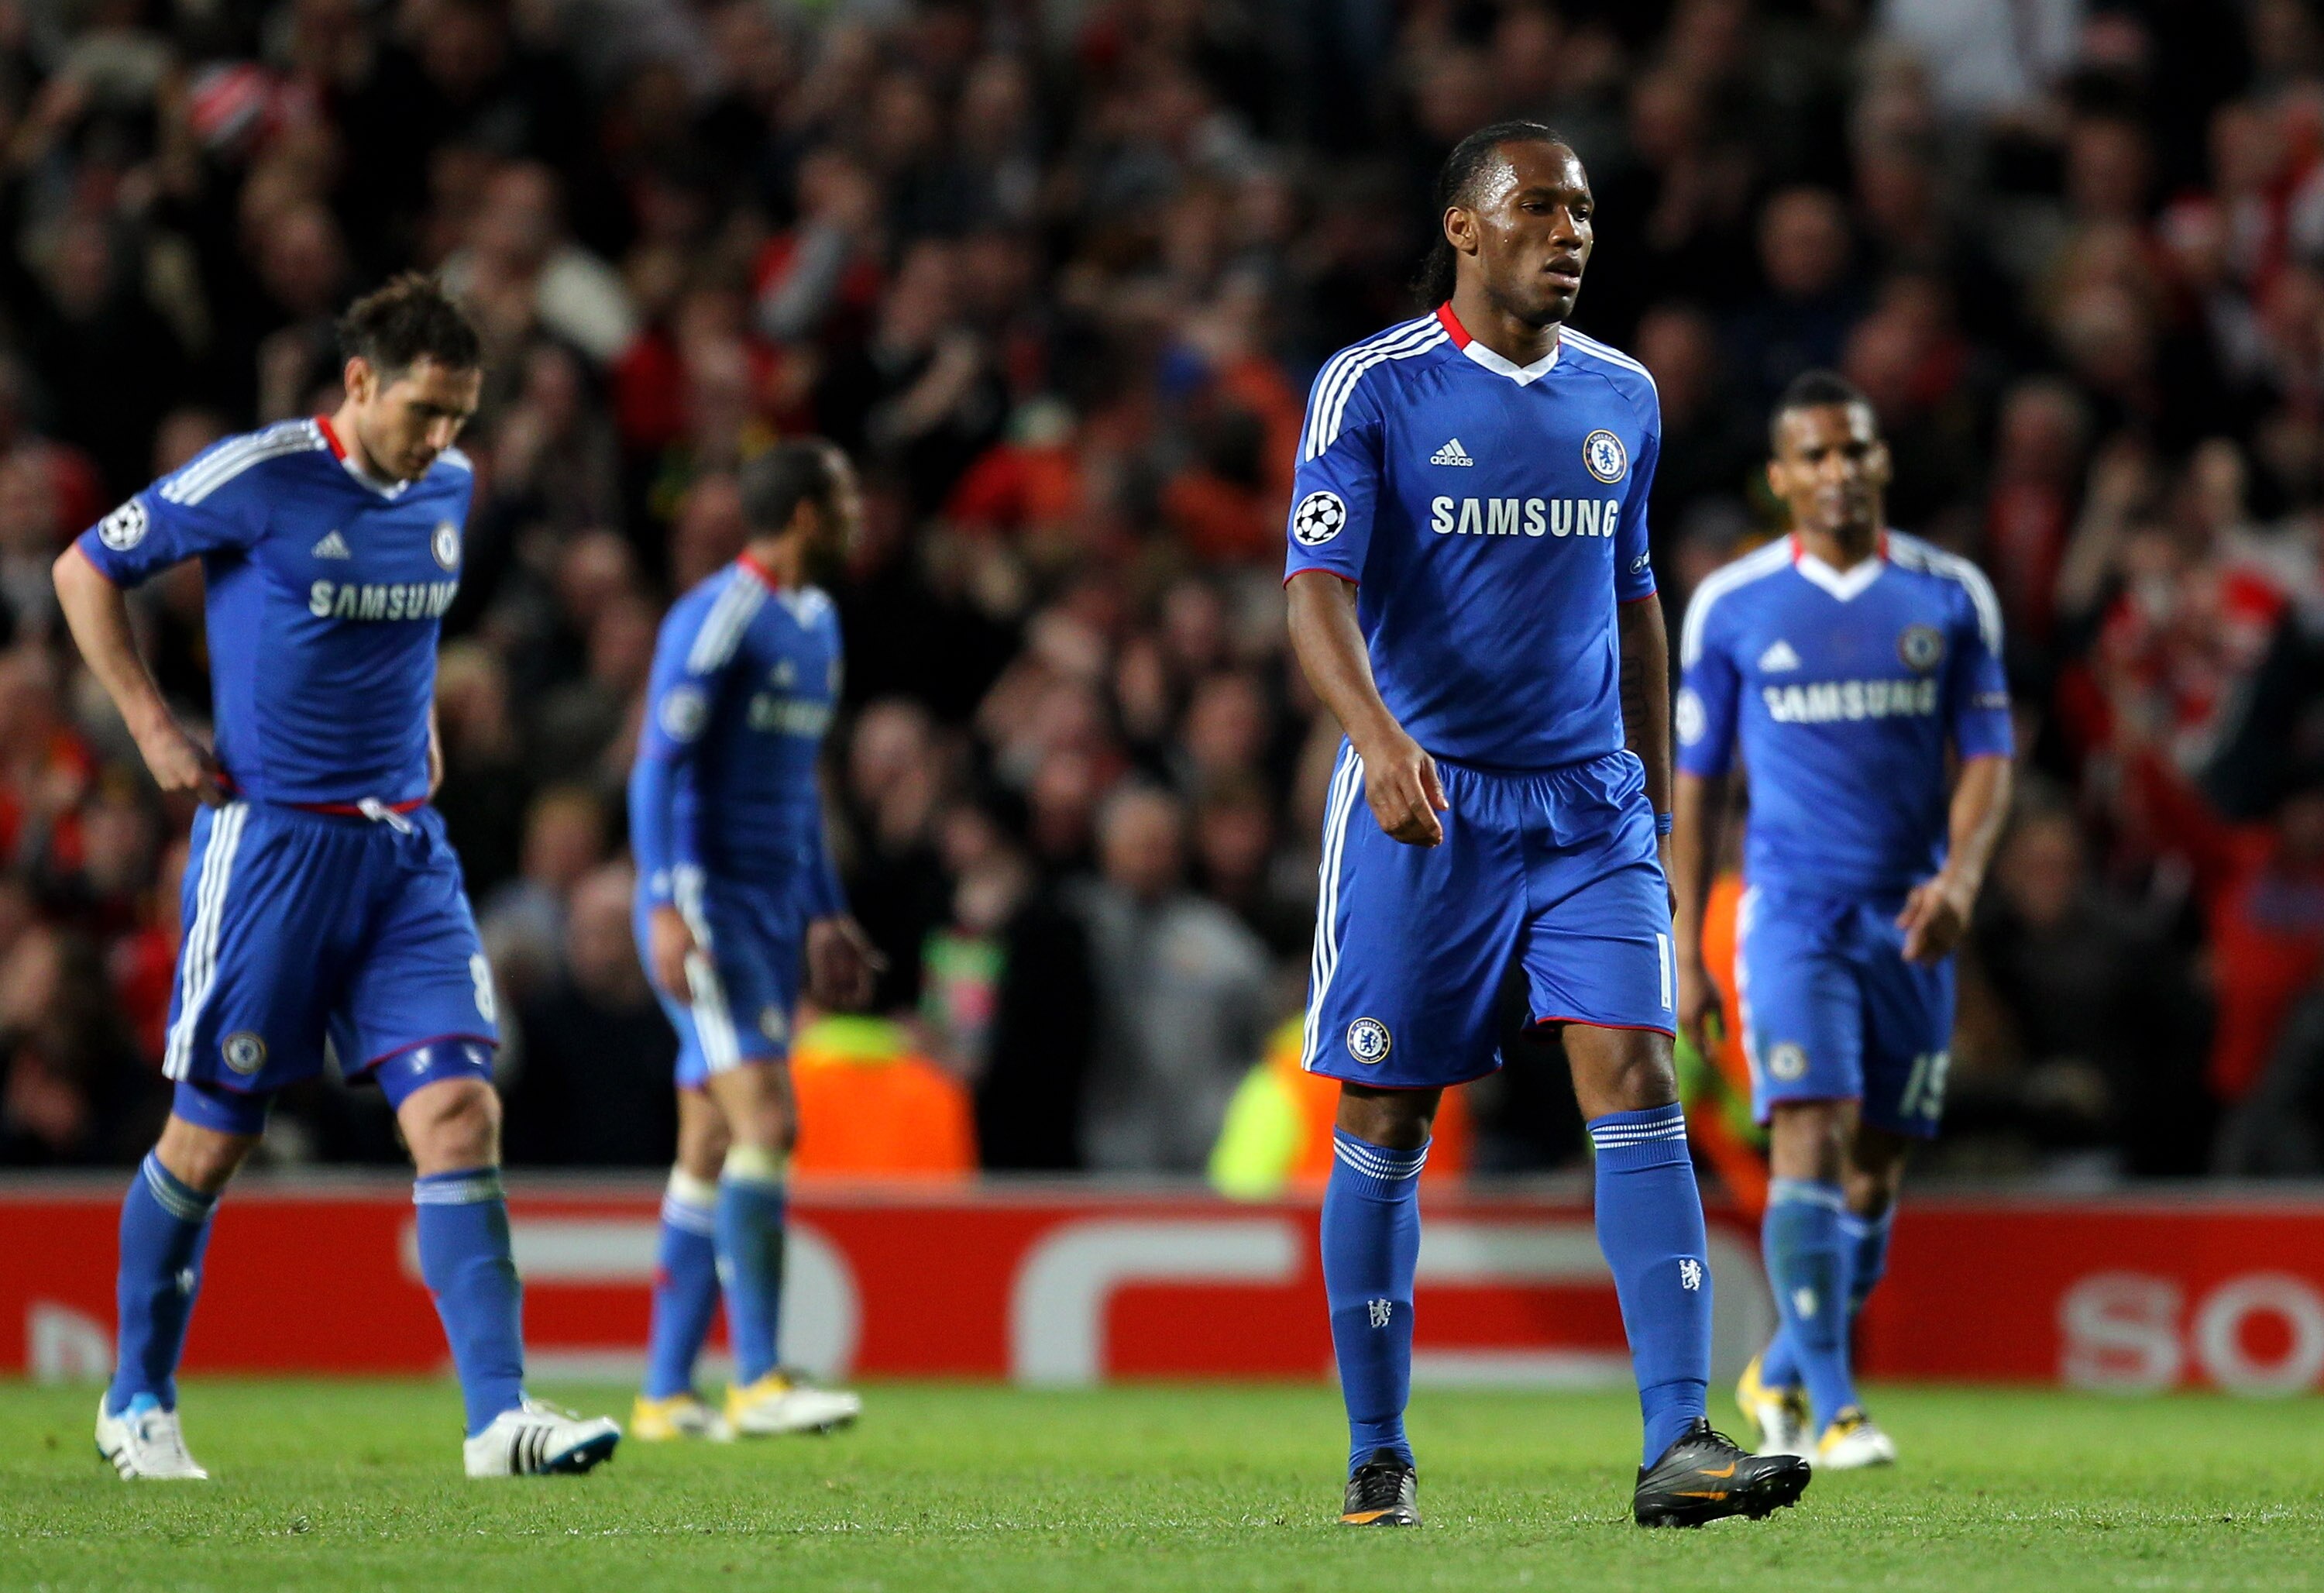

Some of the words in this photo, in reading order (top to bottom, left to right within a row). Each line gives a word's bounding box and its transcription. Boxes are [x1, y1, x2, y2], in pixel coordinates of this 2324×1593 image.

[1430, 454, 1473, 466] adidas
[1590, 434, 1616, 445] CHELSEA
[1431, 496, 1618, 538] SAMSUNG
[1762, 679, 1937, 723] SAMSUNG
[469, 952, 497, 1024] 8
[1356, 1020, 1384, 1034] CHELSEA
[2059, 1272, 2324, 1396] SO
